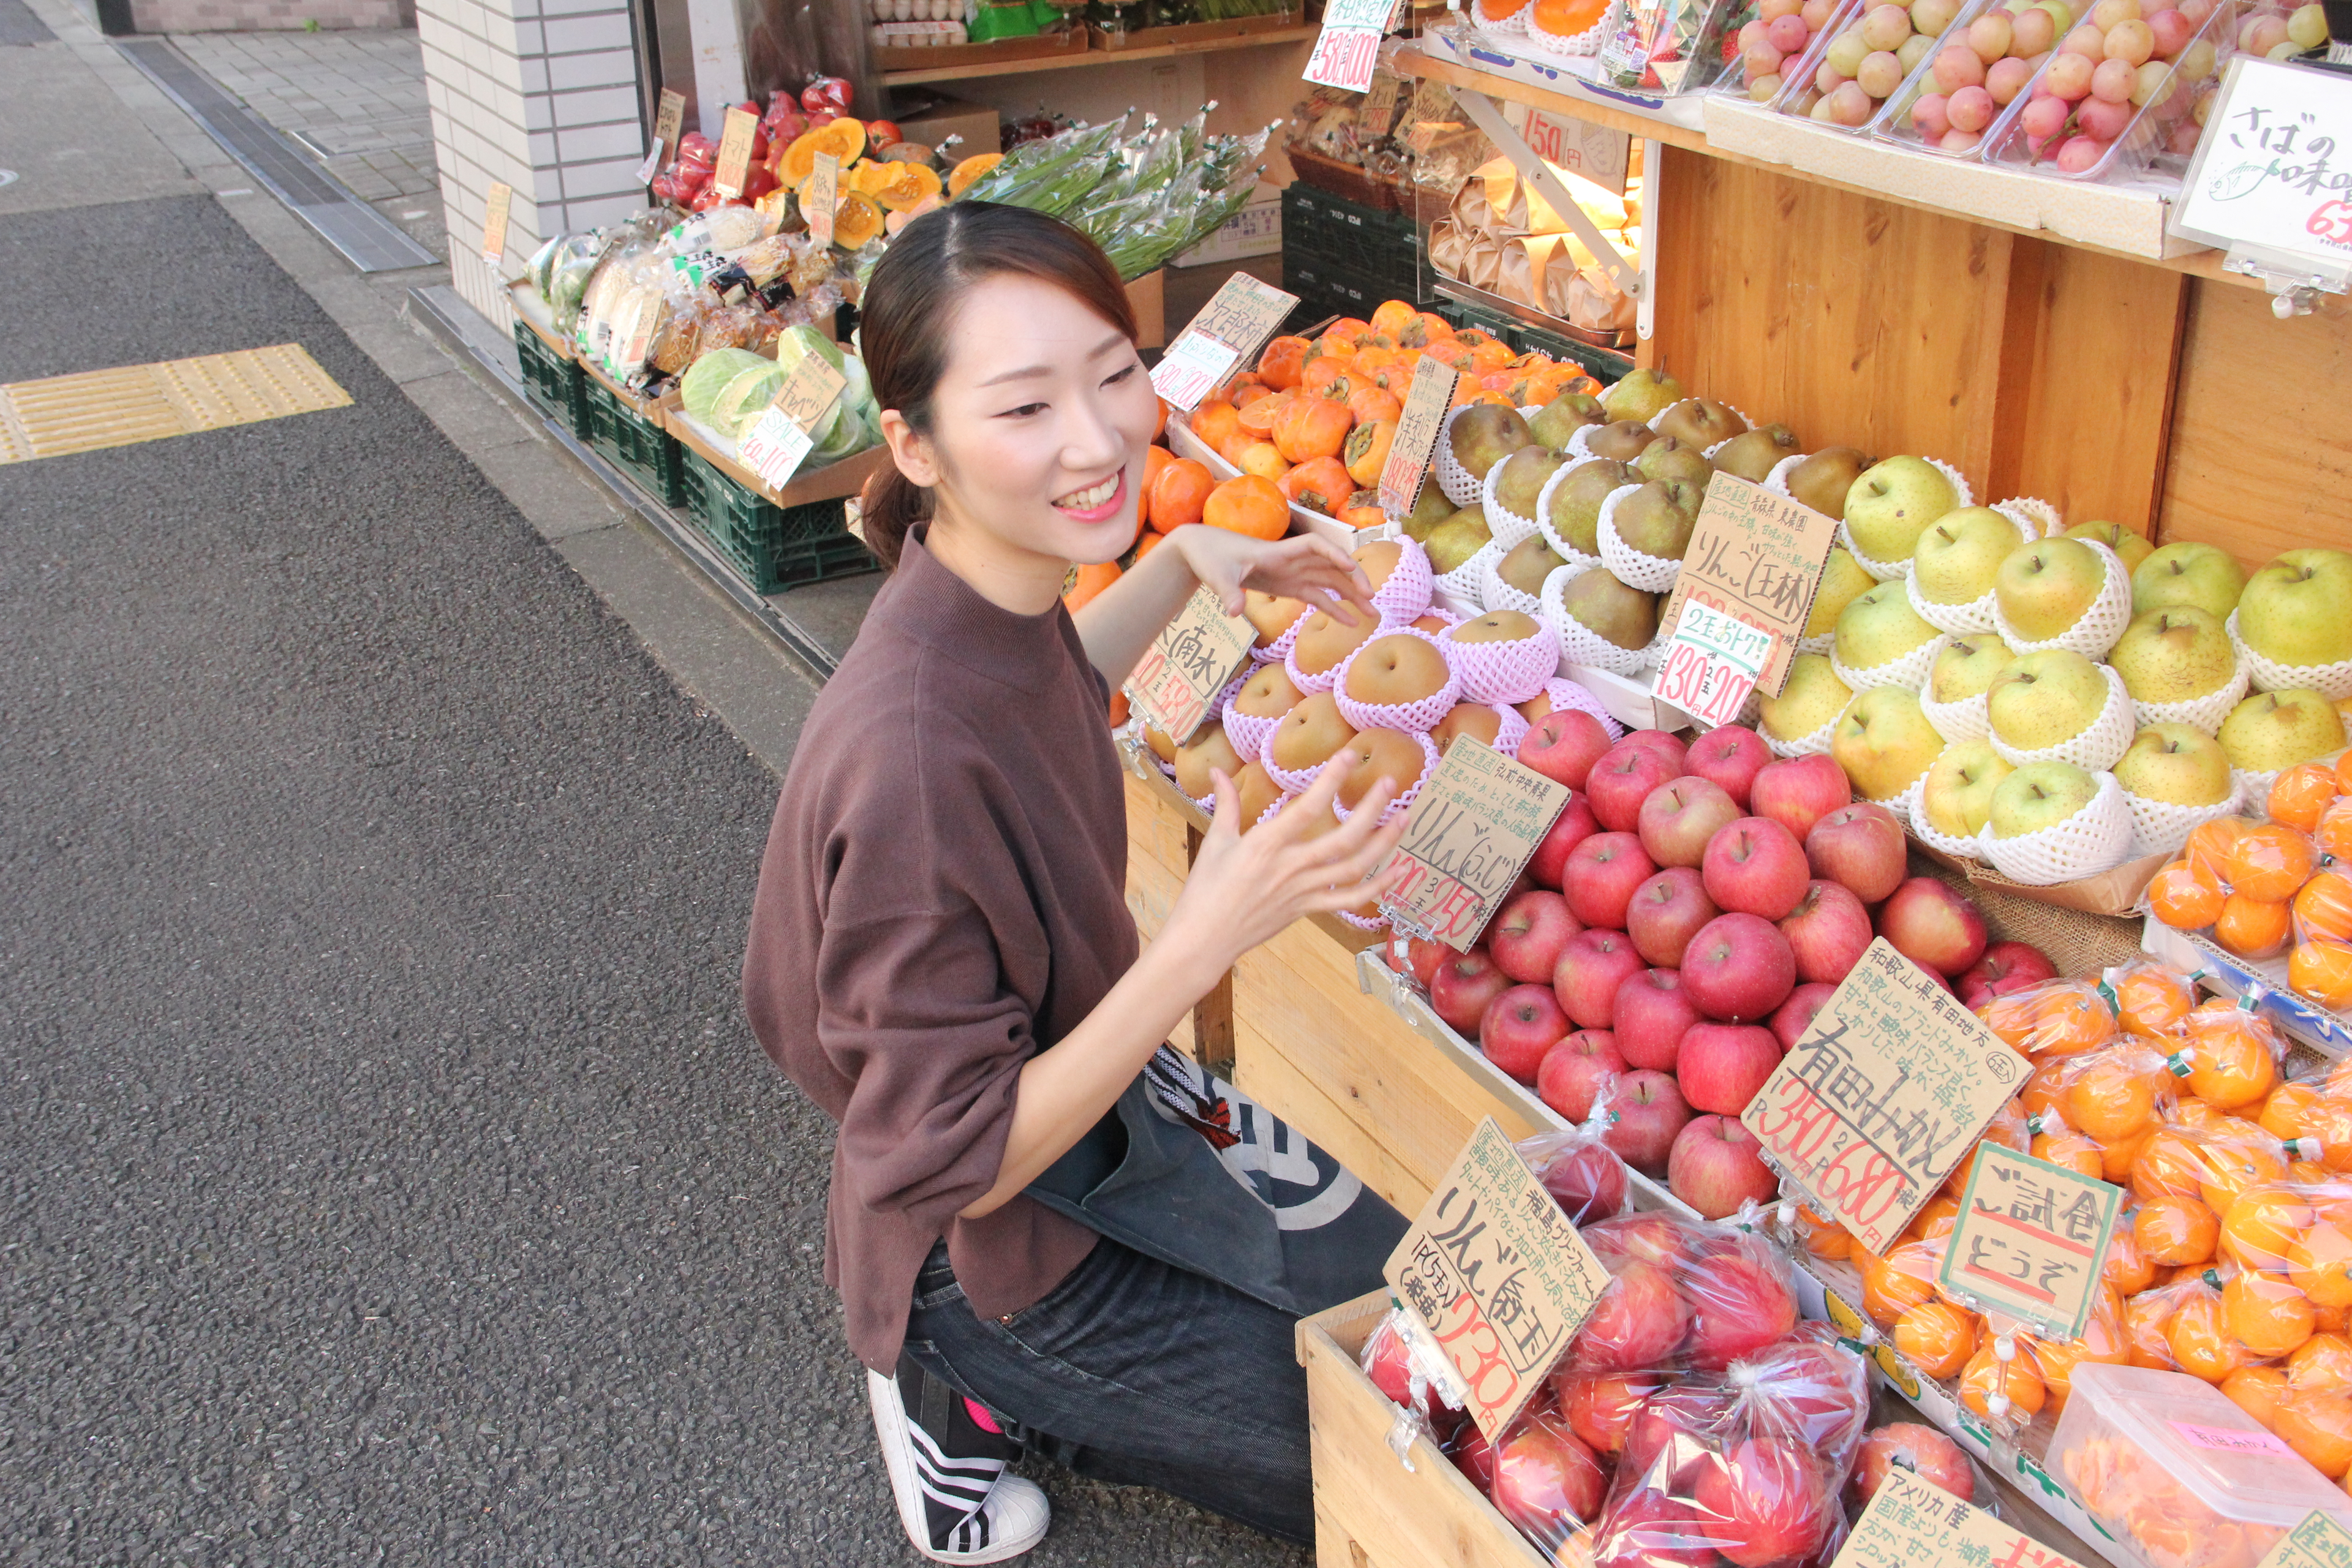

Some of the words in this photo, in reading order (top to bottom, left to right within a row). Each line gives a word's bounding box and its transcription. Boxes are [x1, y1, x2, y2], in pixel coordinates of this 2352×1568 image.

[723, 133, 747, 162] トマト
[2230, 106, 2335, 160] さばの
[1196, 301, 1269, 353] 次郎柿
[766, 410, 805, 450] SALE
[784, 379, 824, 423] キャベツ
[1711, 480, 1750, 508] 産地直送
[1751, 495, 1776, 519] 青森県
[1696, 530, 1811, 624] りんご(王林)
[1452, 739, 1498, 774] 産地直送
[1493, 762, 1552, 802] 弘前中央青果
[1408, 797, 1517, 899] りんご(ふじ)
[1855, 966, 1983, 1087] 和歌山のブランドみかん。
[1868, 946, 1991, 1048] 和歌山県有田地方
[1798, 1017, 1961, 1180] 有田みかん
[1479, 1129, 1530, 1191] 産地直送
[1525, 1188, 1595, 1294] 福島グリーンファーム
[1975, 1164, 2103, 1243] ご試食
[1432, 1186, 1564, 1373] りんご(紅玉)
[1967, 1234, 2078, 1295] どうぞ
[2187, 1427, 2280, 1453] 有田みかん
[1888, 1472, 1972, 1530] アメリカ産
